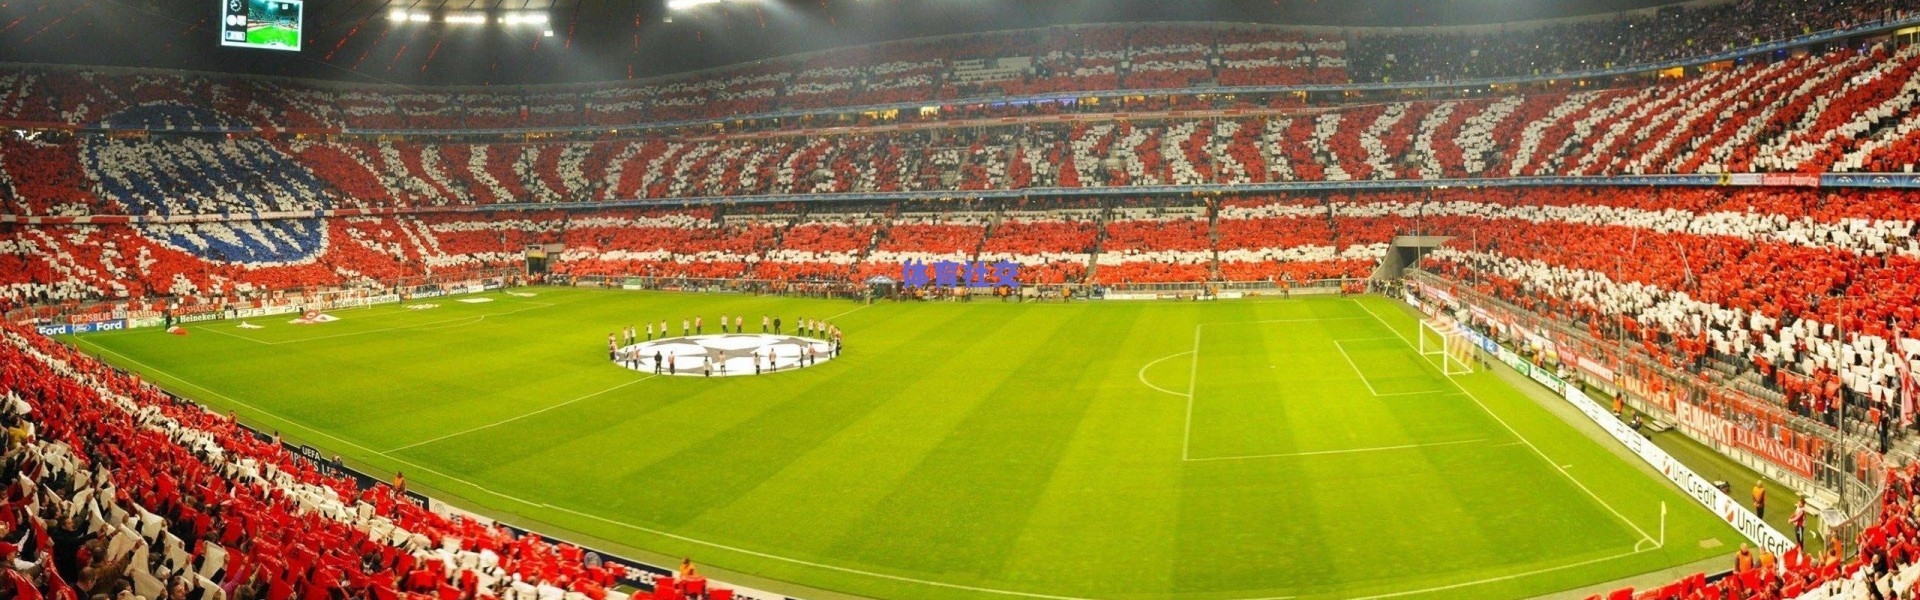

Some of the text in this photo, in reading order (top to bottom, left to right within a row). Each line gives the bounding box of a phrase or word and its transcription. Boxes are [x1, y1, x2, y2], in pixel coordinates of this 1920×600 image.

[38, 325, 66, 335] Ford
[96, 321, 122, 331] Ford
[180, 312, 217, 323] Heineken
[1676, 399, 1734, 447] NEUMARKT
[301, 446, 321, 461] UEFA
[1736, 427, 1811, 474] ELLWANGEN
[1673, 462, 1717, 510] UniCredit
[1737, 508, 1795, 556] UniCredi
